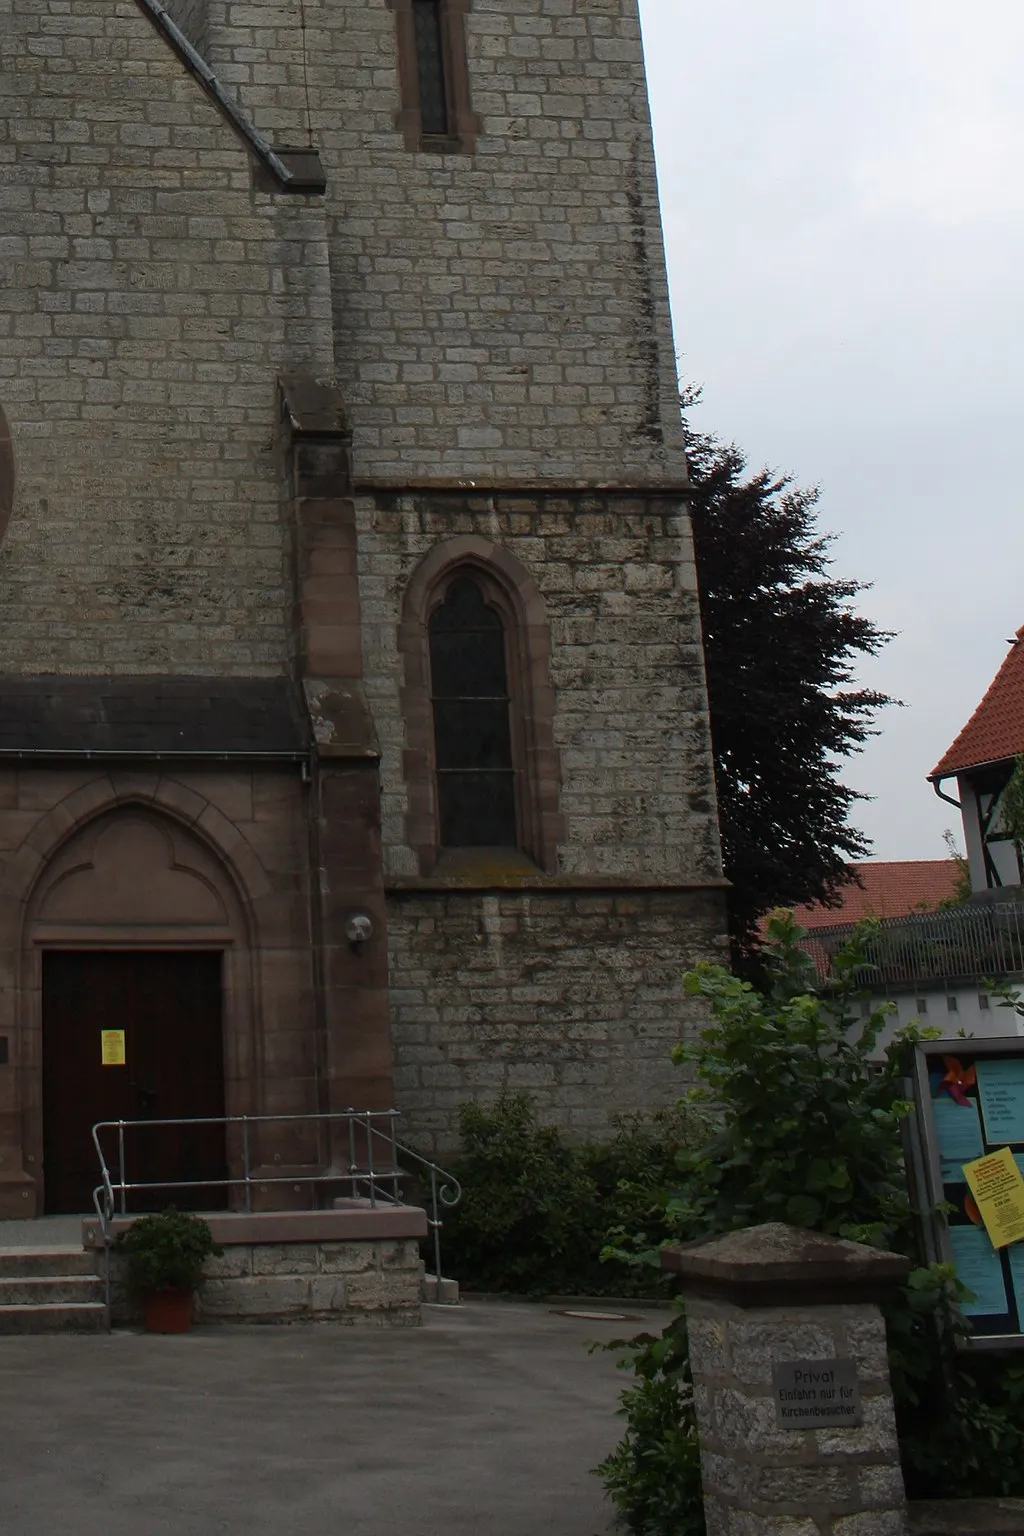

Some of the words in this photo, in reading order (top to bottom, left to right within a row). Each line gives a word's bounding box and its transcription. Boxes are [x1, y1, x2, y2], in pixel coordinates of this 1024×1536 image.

[794, 1369, 834, 1383] Privat
[778, 1388, 816, 1401] Einfahrt
[820, 1387, 836, 1399] nur
[840, 1385, 854, 1399] für
[781, 1405, 856, 1418] Kirchenbesucher
